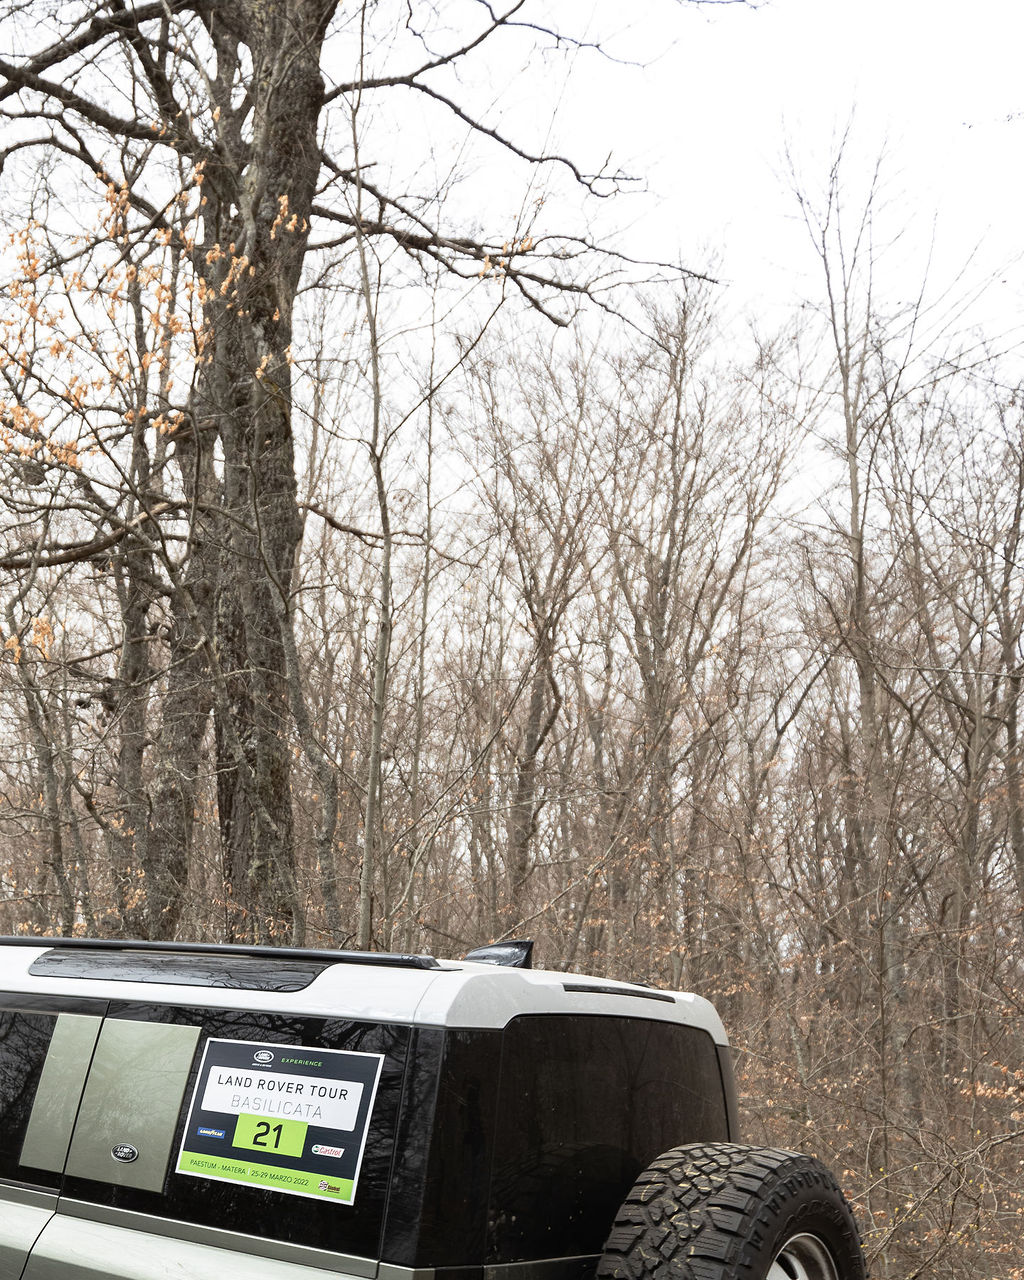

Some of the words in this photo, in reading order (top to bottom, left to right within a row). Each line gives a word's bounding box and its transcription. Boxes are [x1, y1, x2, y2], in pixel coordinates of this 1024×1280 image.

[281, 1058, 323, 1067] EXPERIENCE
[217, 1074, 252, 1088] LAND
[257, 1079, 305, 1095] ROVER
[310, 1085, 349, 1101] TOUR
[231, 1094, 323, 1119] BASILICATA
[252, 1121, 283, 1149] 21
[189, 1159, 217, 1169] PAESTUM
[221, 1165, 246, 1175] MATERA
[268, 1173, 292, 1183] MARZO
[293, 1177, 310, 1187] 2022
